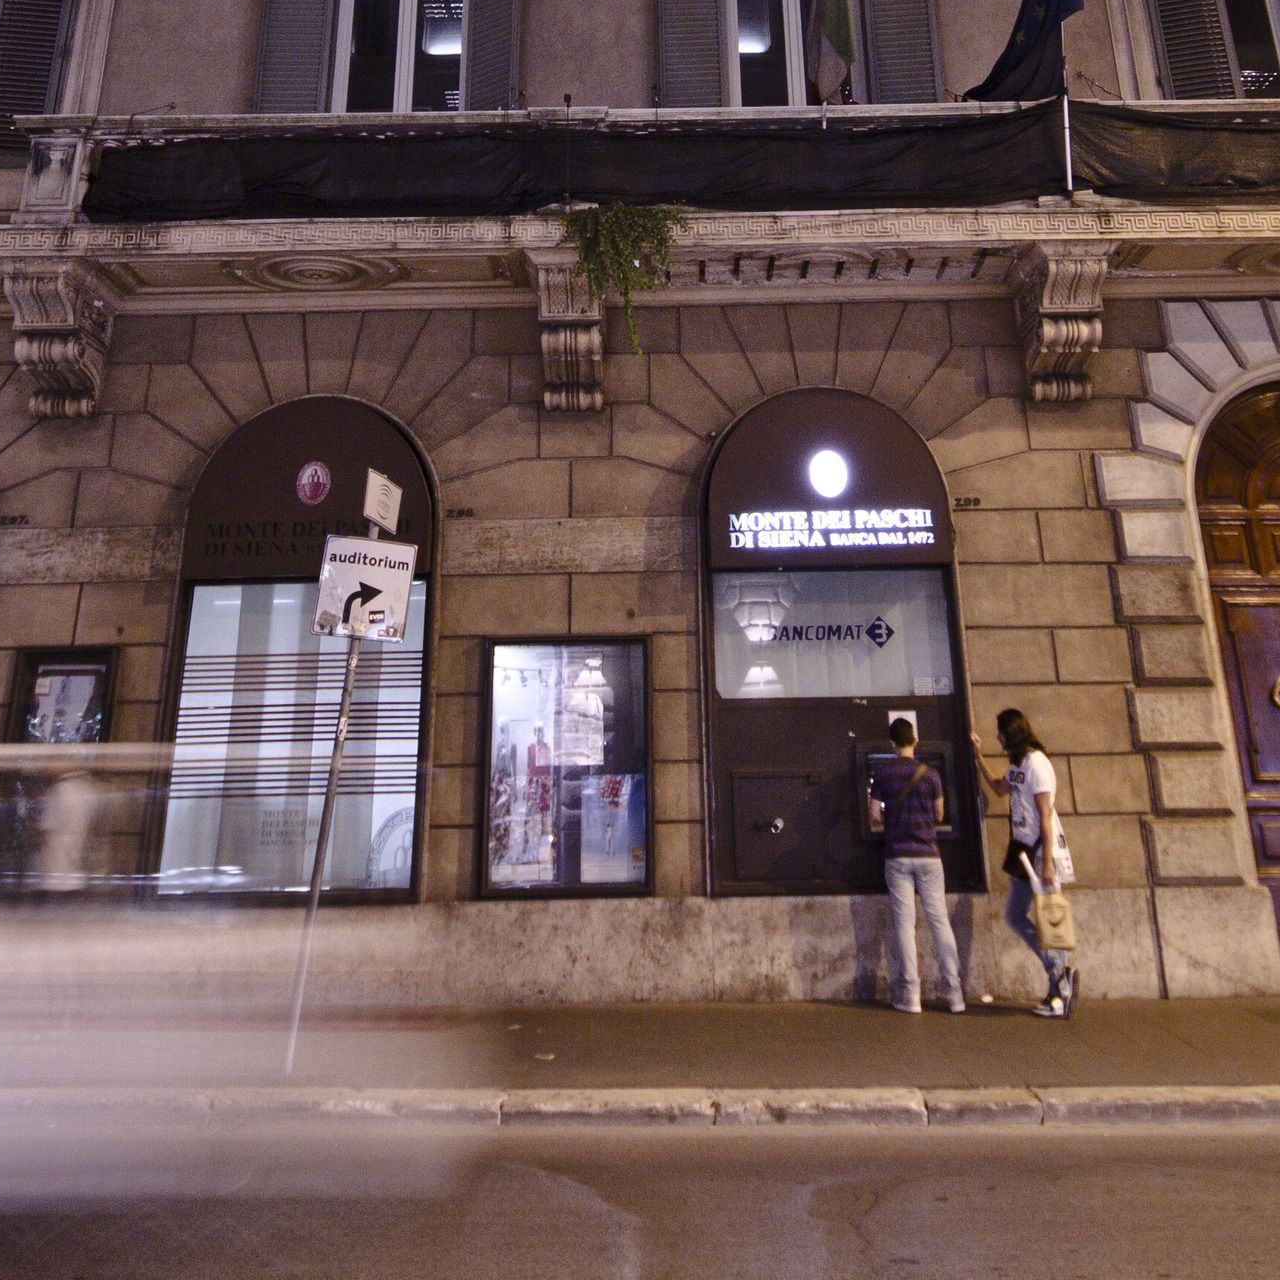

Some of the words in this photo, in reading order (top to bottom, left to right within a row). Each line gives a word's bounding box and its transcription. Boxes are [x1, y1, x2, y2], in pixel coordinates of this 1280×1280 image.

[728, 511, 809, 531] MONTE
[812, 510, 851, 530] DEI
[854, 509, 934, 529] PASCHI
[729, 531, 755, 548] DI
[758, 530, 826, 548] SIENA
[878, 532, 907, 545] DAL
[329, 551, 409, 571] auditorium
